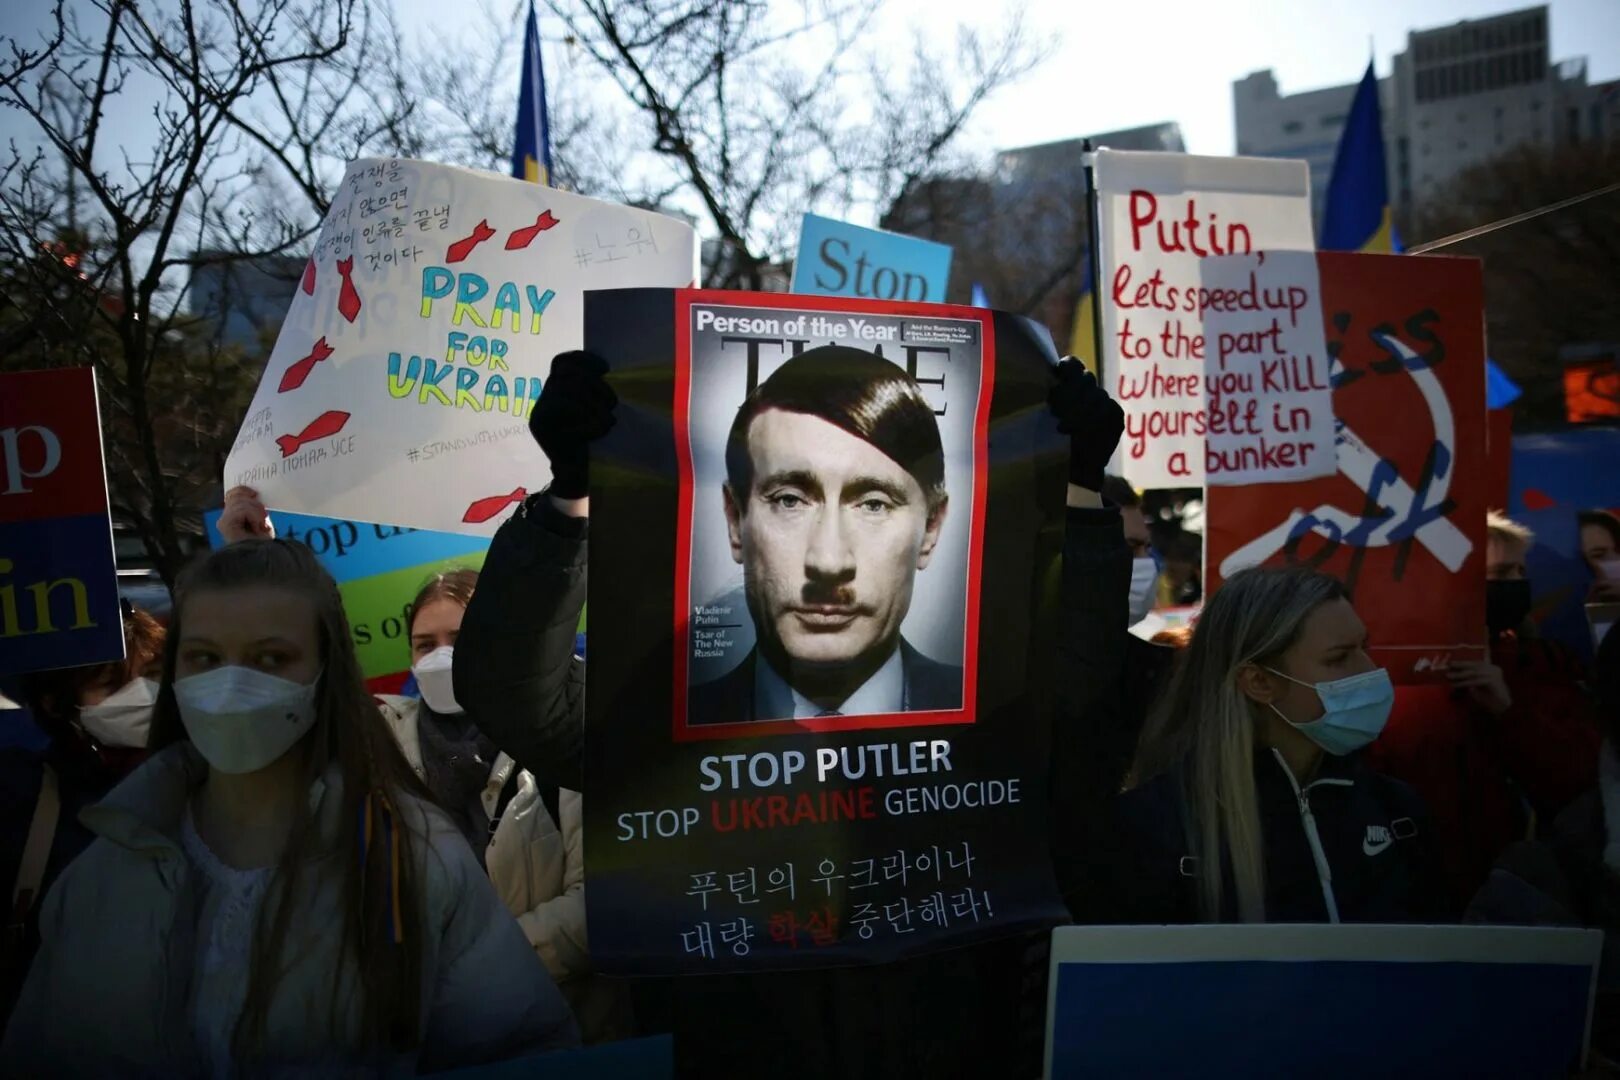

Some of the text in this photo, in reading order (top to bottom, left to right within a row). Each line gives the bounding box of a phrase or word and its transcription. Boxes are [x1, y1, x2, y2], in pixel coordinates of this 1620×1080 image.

[1128, 190, 1266, 266] Putin,
[364, 246, 424, 272] 것이다
[420, 266, 555, 334] PRAY
[1263, 286, 1309, 326] up
[697, 310, 899, 341] Person of the Year
[1117, 318, 1286, 370] to the part
[445, 331, 509, 371] FOR
[1204, 373, 1253, 409] you
[1273, 404, 1311, 434] in
[331, 434, 357, 458] УСЕ
[1168, 436, 1316, 477] a bunker
[694, 605, 732, 616] Vladimir
[695, 615, 719, 625] Putin
[694, 639, 734, 649] The New
[694, 648, 724, 658] Russia
[695, 629, 725, 639] Tsar of
[699, 739, 953, 792] STOP PUTLER
[616, 778, 1022, 842] STOP UKRAINE GENOCIDE
[685, 841, 977, 911] 푸틴의 우크라이나
[680, 887, 994, 960] 대량 학살 중단해라!
